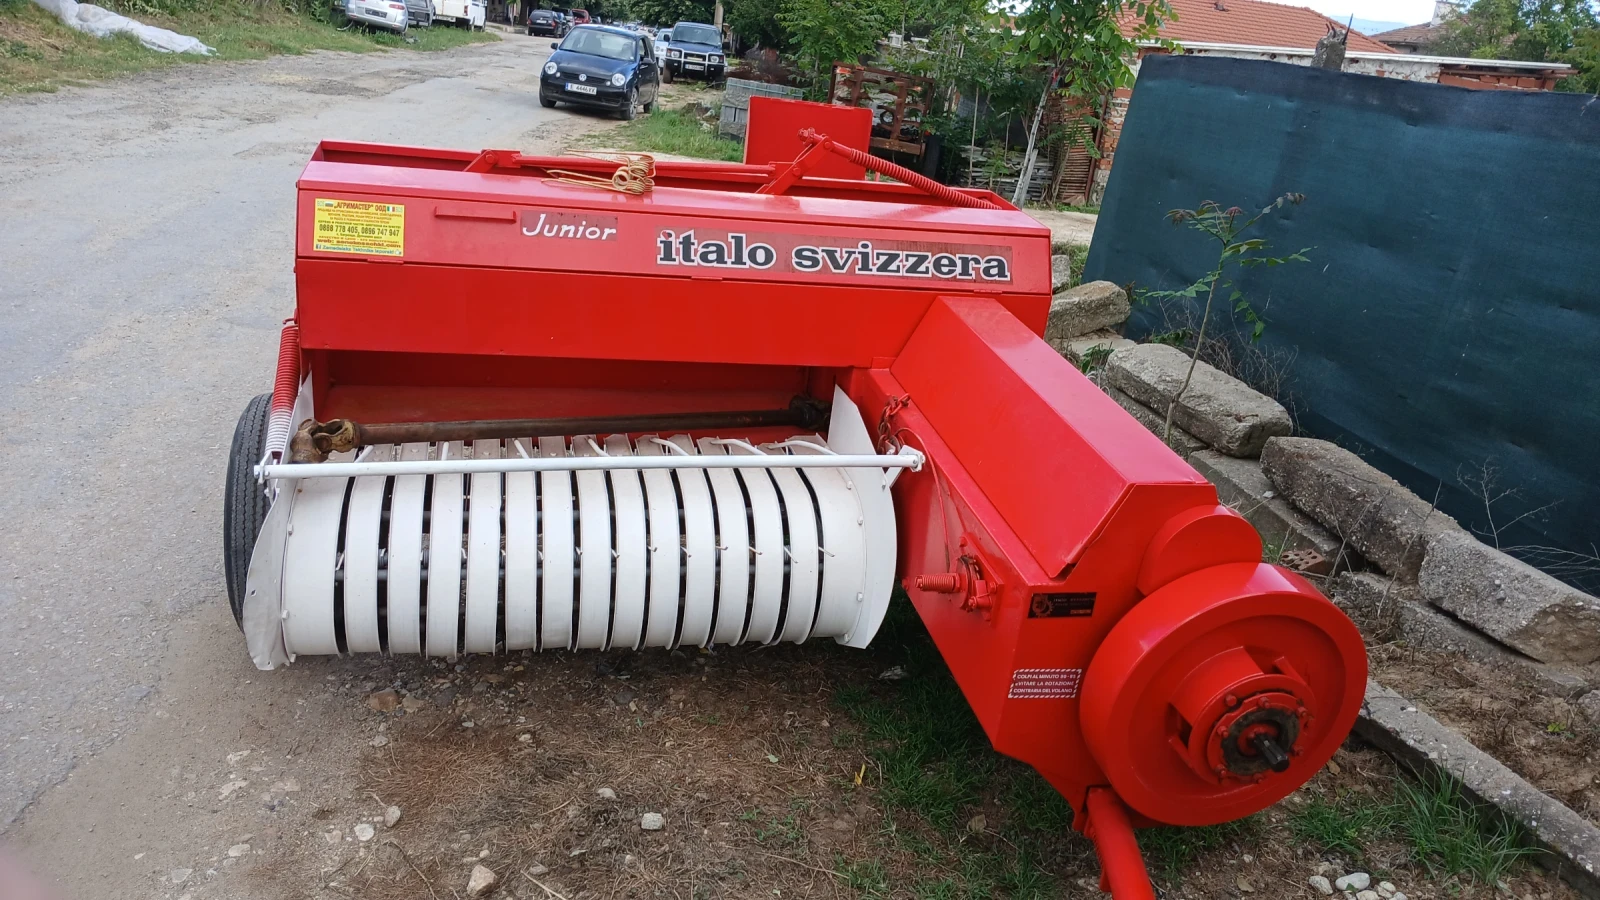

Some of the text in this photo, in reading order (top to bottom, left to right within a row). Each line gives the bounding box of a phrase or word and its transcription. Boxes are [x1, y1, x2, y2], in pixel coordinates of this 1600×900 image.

[377, 227, 387, 236] 747
[389, 228, 400, 237] 947
[522, 213, 617, 241] Junior
[657, 229, 1010, 281] italo svizzera
